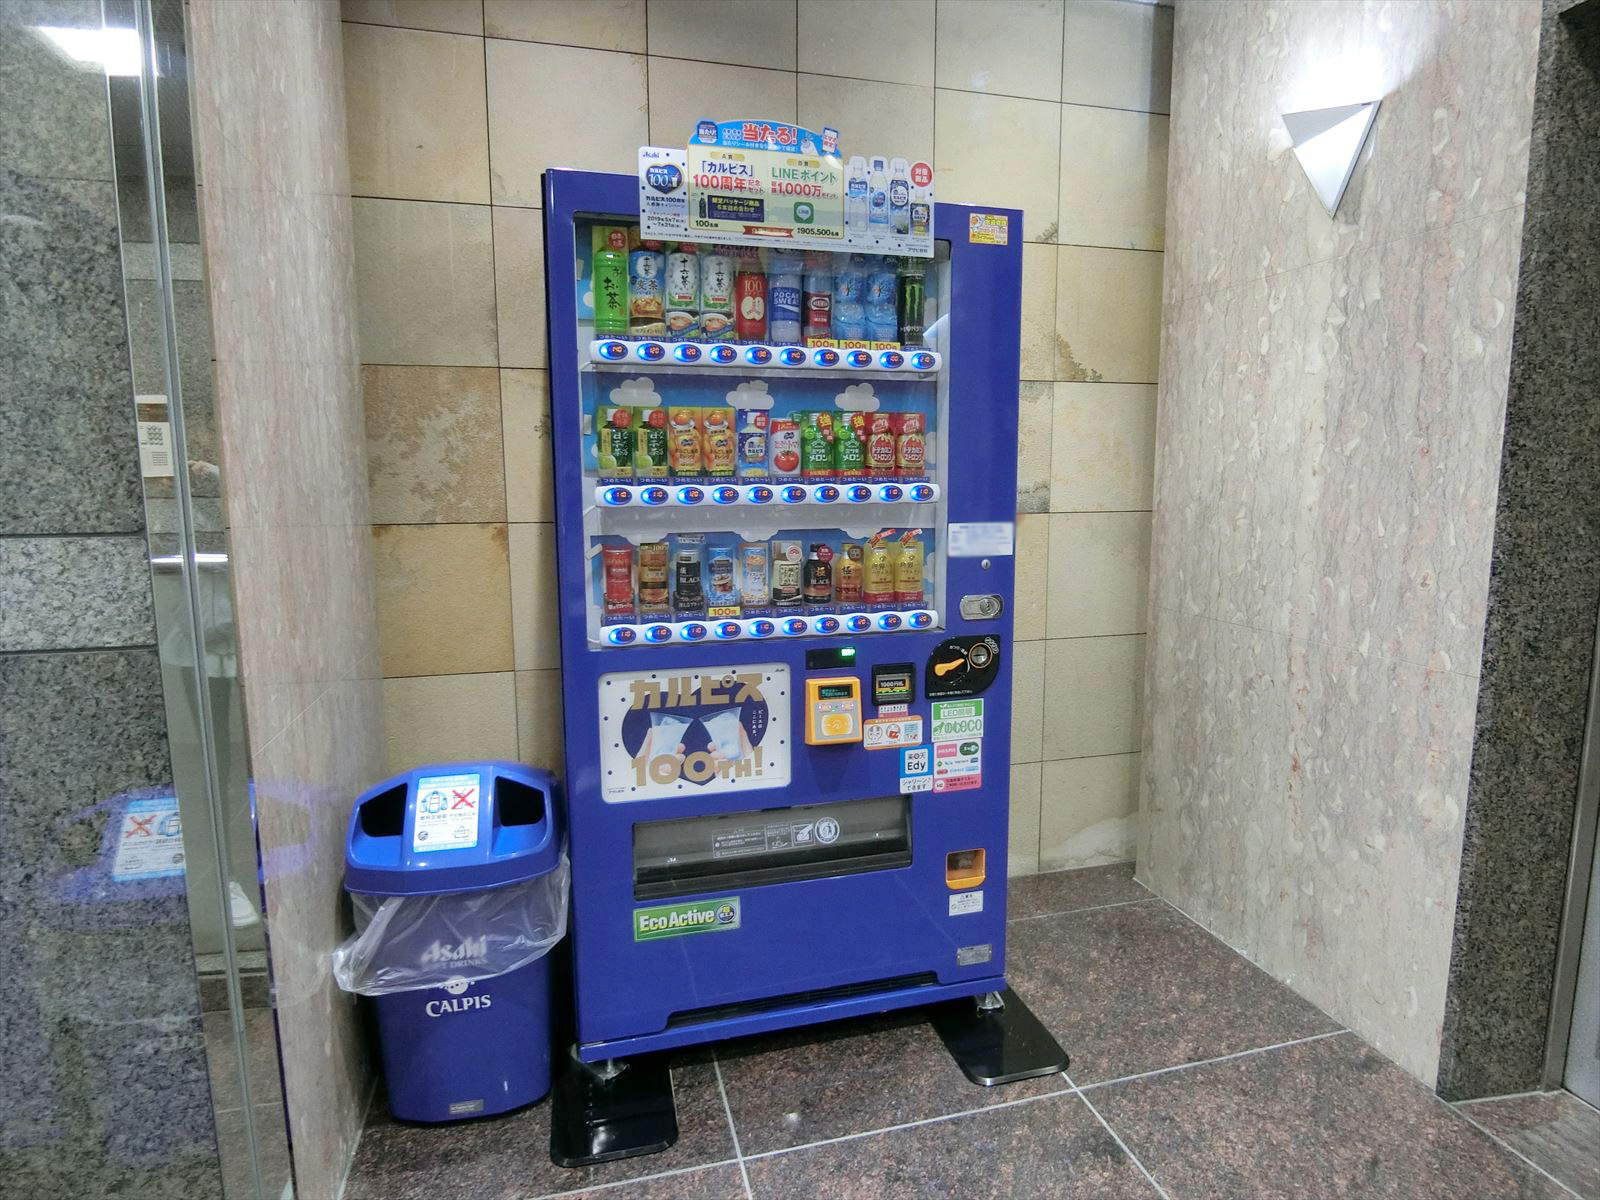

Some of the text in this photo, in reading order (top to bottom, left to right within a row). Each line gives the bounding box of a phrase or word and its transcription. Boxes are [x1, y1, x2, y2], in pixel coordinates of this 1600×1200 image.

[742, 123, 798, 145] 当たる!
[693, 174, 746, 192] 100周年
[630, 672, 763, 711] カルピス
[907, 761, 926, 771] Edy
[420, 934, 487, 963] Asahi
[426, 994, 492, 1017] CALPIS
